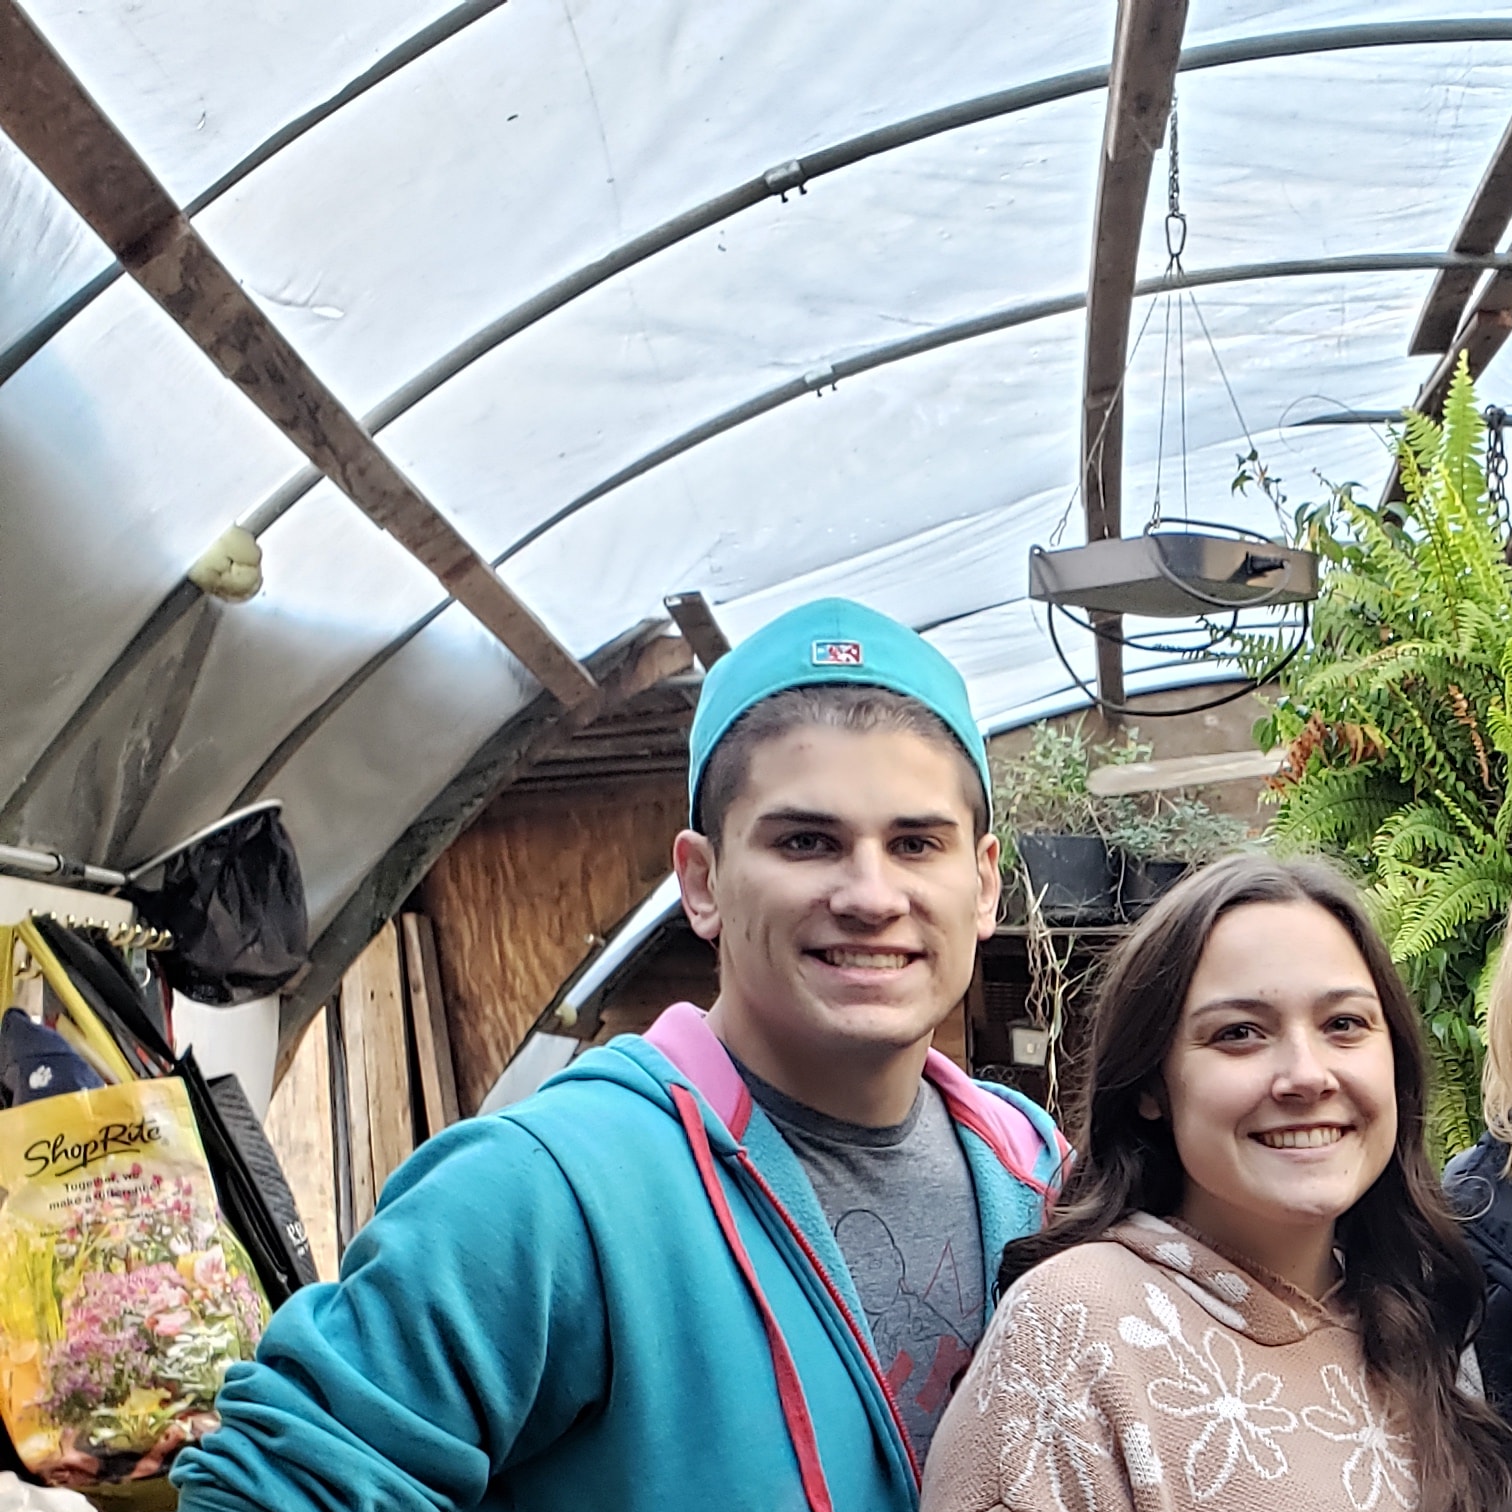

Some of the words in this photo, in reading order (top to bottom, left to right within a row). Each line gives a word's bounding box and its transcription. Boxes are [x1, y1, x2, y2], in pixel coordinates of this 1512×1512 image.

[24, 1116, 161, 1178] ShopRite
[48, 1195, 82, 1211] make
[85, 1194, 92, 1204] a
